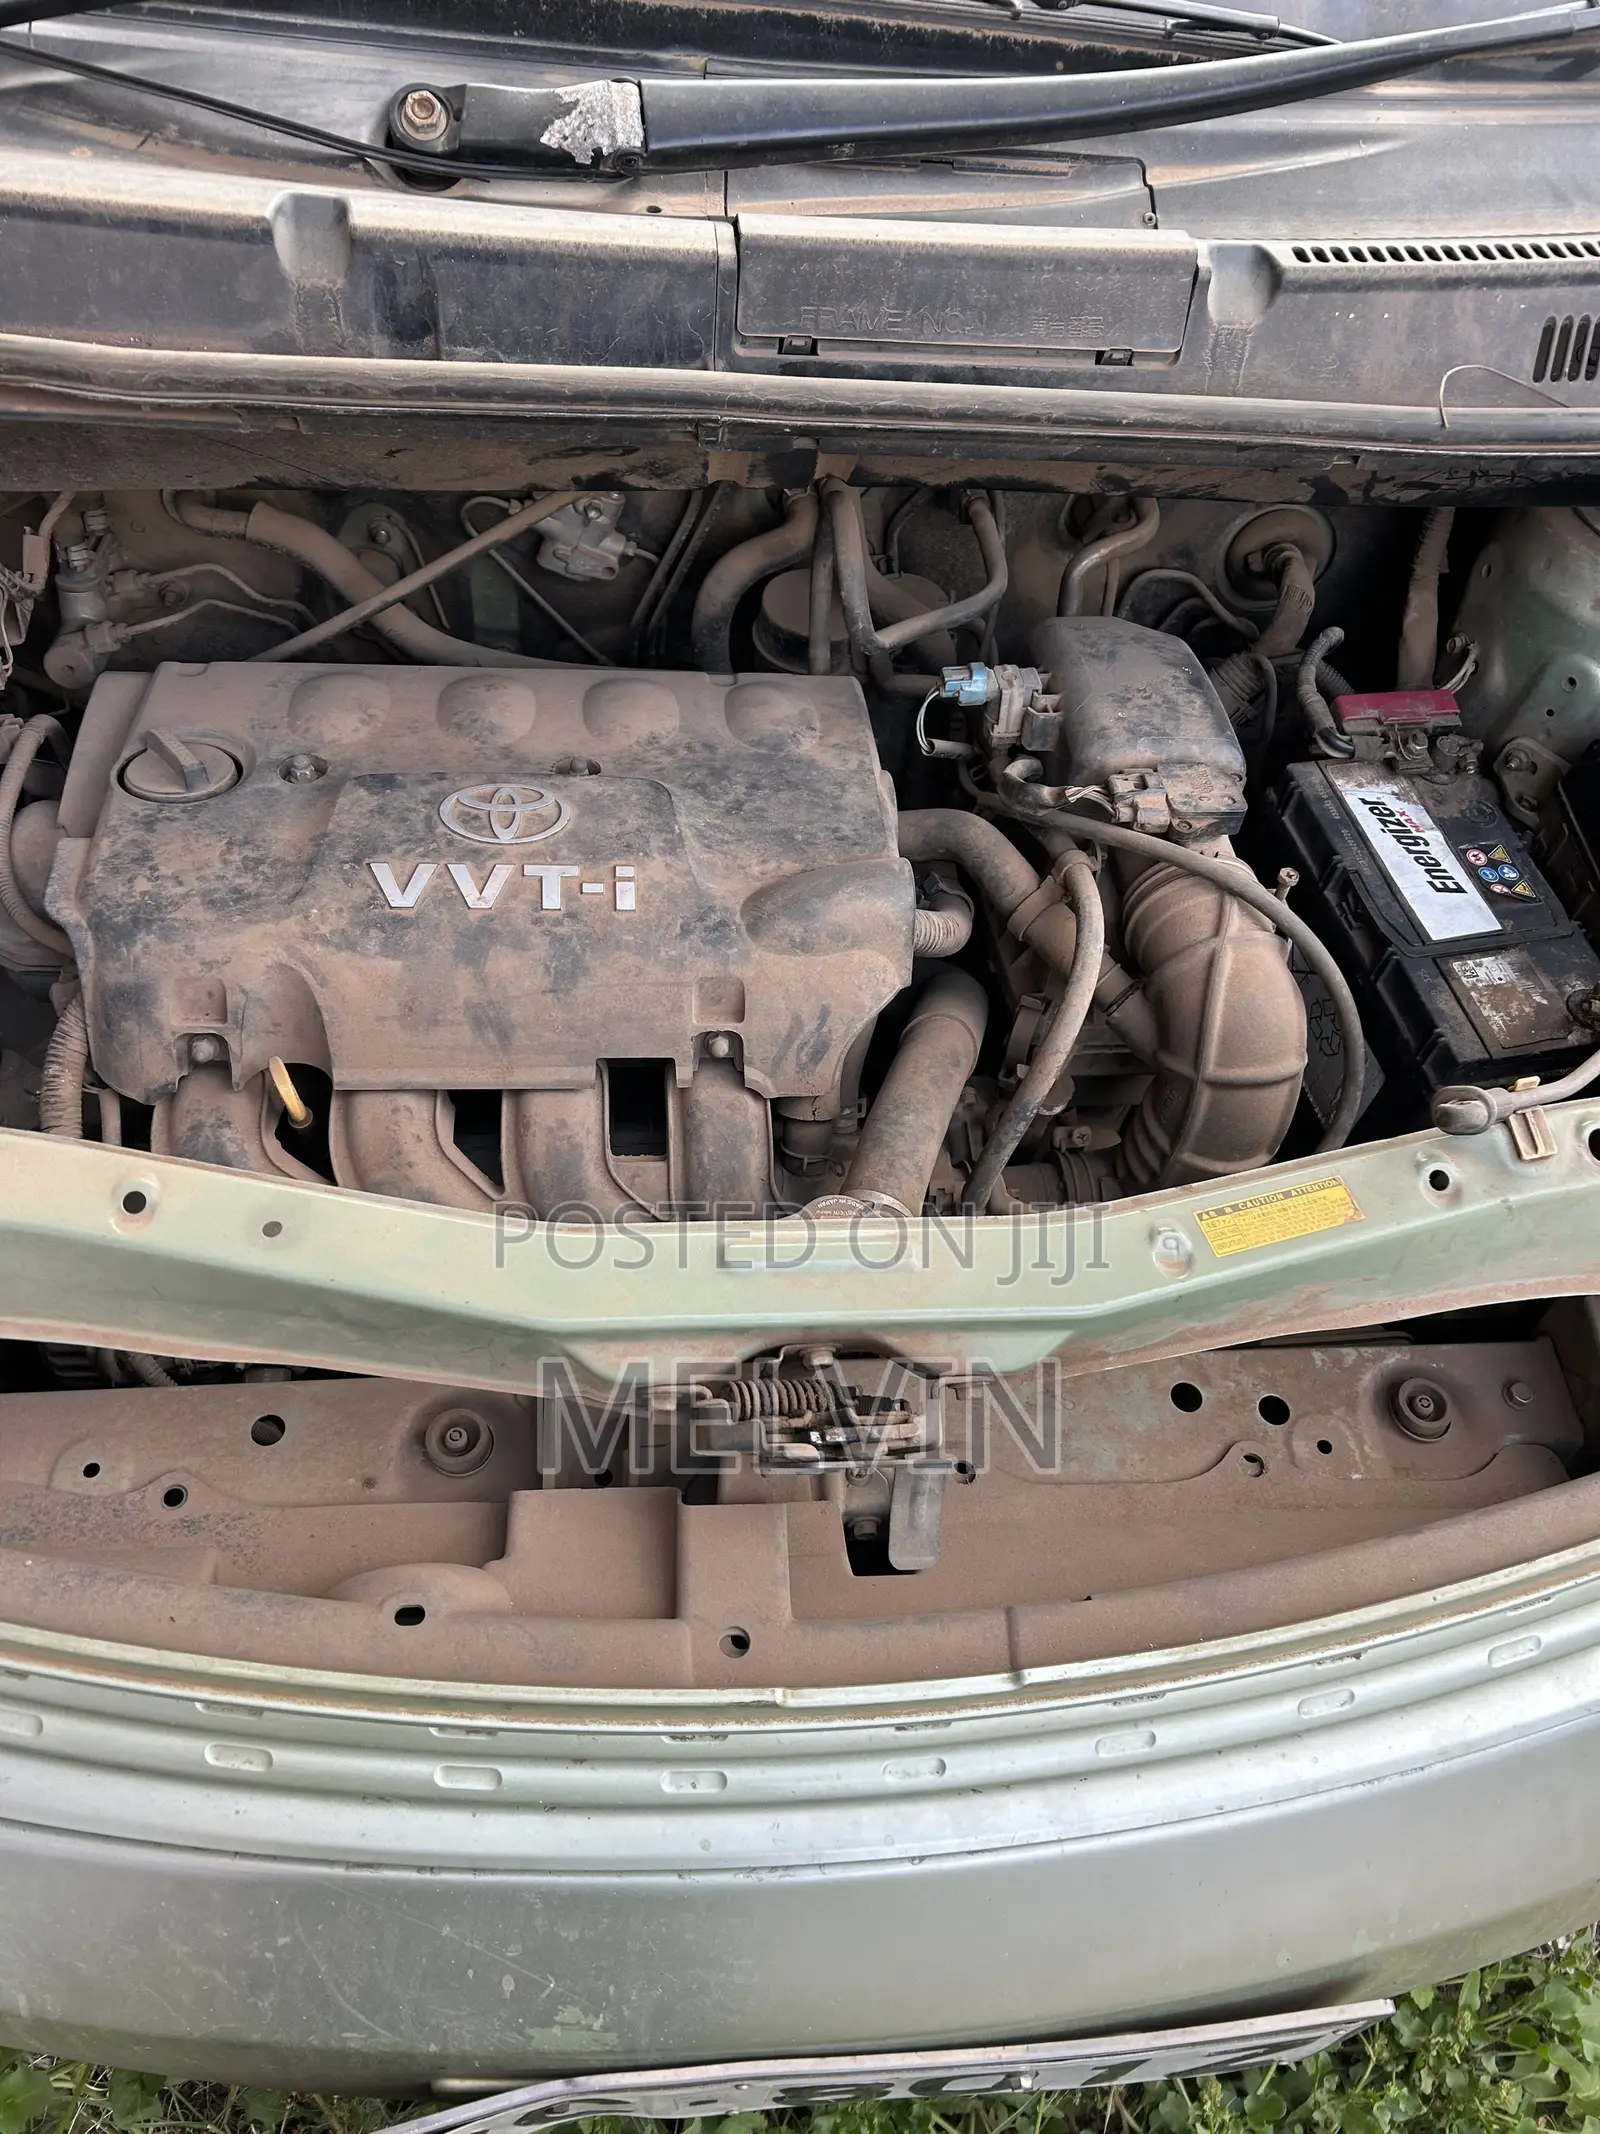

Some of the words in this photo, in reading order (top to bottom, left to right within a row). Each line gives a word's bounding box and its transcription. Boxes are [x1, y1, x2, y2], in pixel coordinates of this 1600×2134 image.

[799, 305, 906, 331] FRAME
[1357, 797, 1468, 894] Energizer
[366, 862, 637, 911] VVT-i
[817, 1198, 838, 1209] JAPAN
[1238, 1192, 1285, 1210] CAUTION
[1291, 1177, 1340, 1197] ATTENTION
